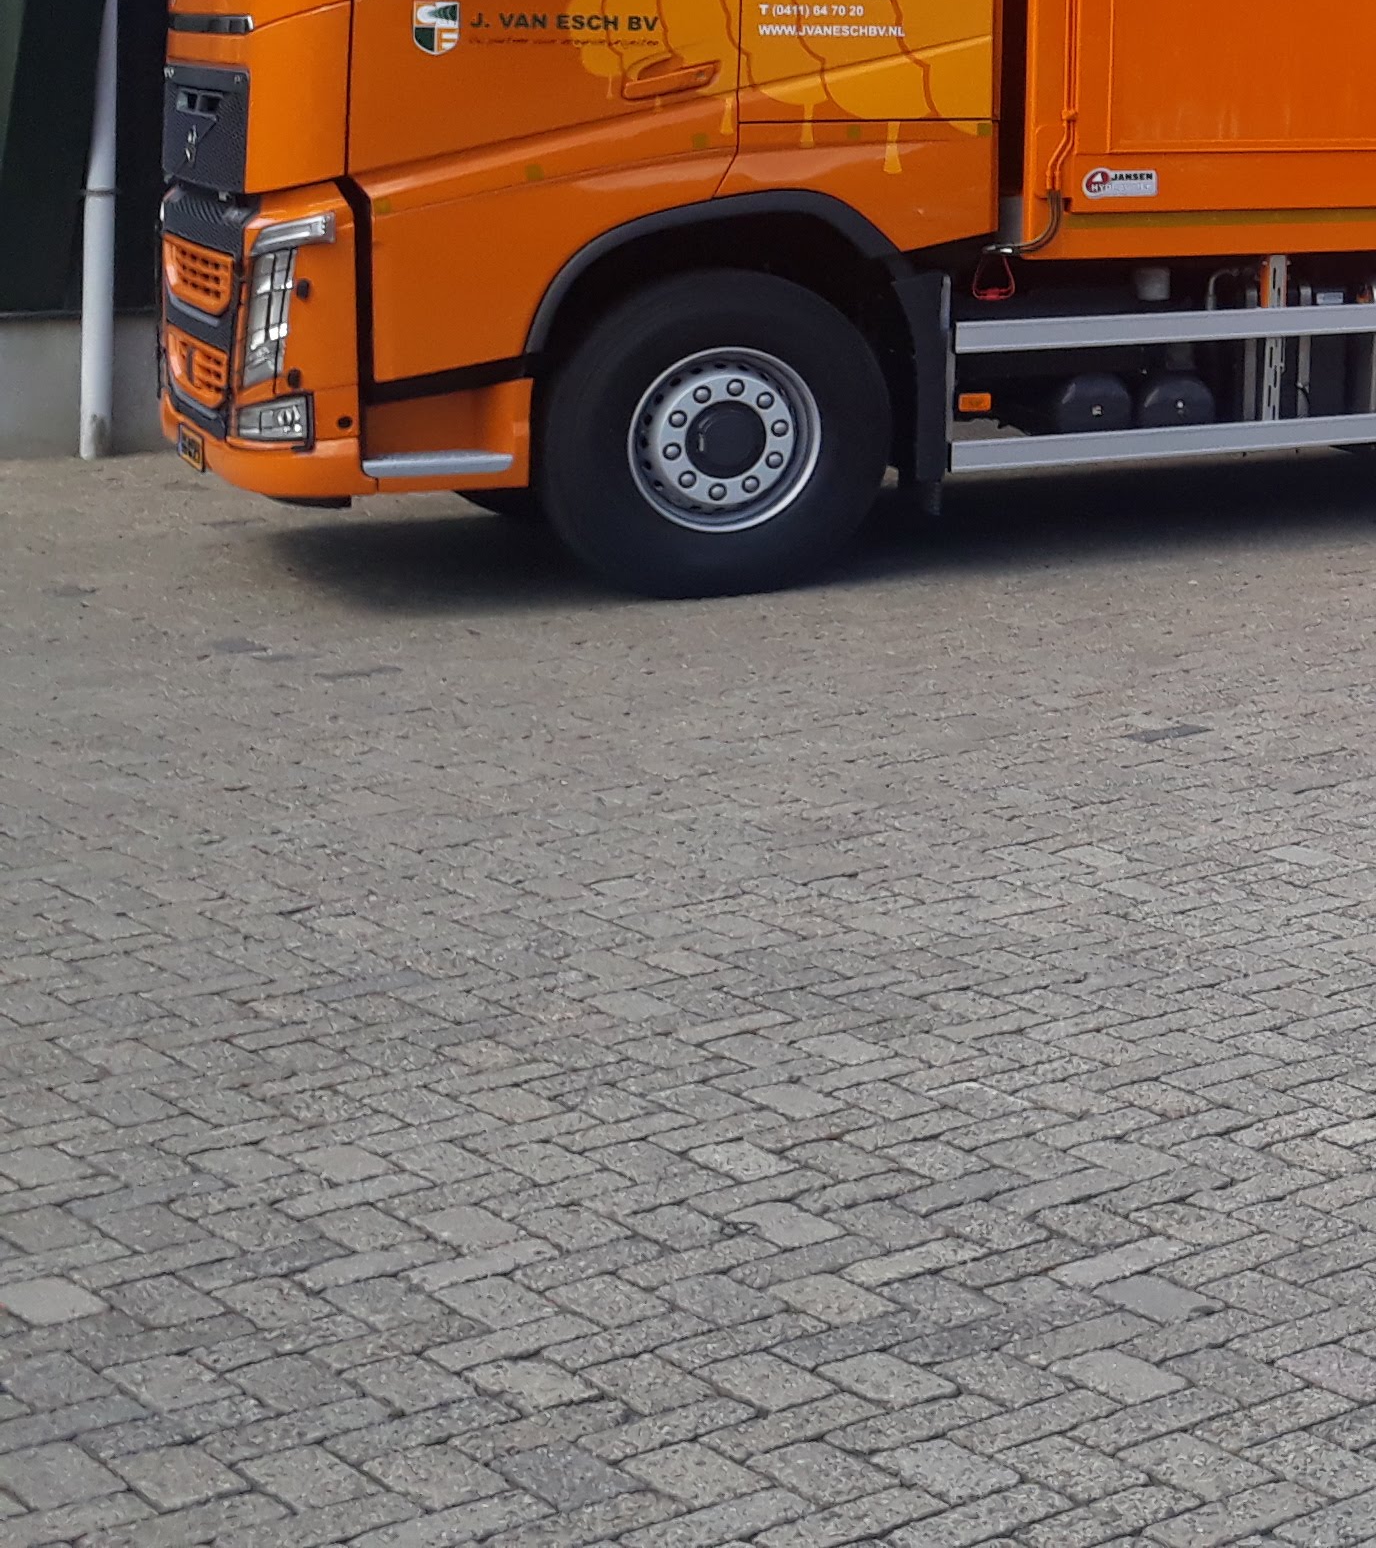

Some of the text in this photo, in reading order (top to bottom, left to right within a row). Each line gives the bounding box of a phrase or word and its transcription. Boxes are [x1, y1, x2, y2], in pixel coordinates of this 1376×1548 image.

[759, 4, 769, 15] T
[772, 4, 810, 19] (0411)
[832, 5, 846, 16] 70
[849, 6, 864, 17] 20
[470, 12, 659, 32] J. VAN ESCH BV
[758, 24, 905, 38] WWW.JVANESCHBV.NL
[1111, 173, 1153, 181] JANSEN
